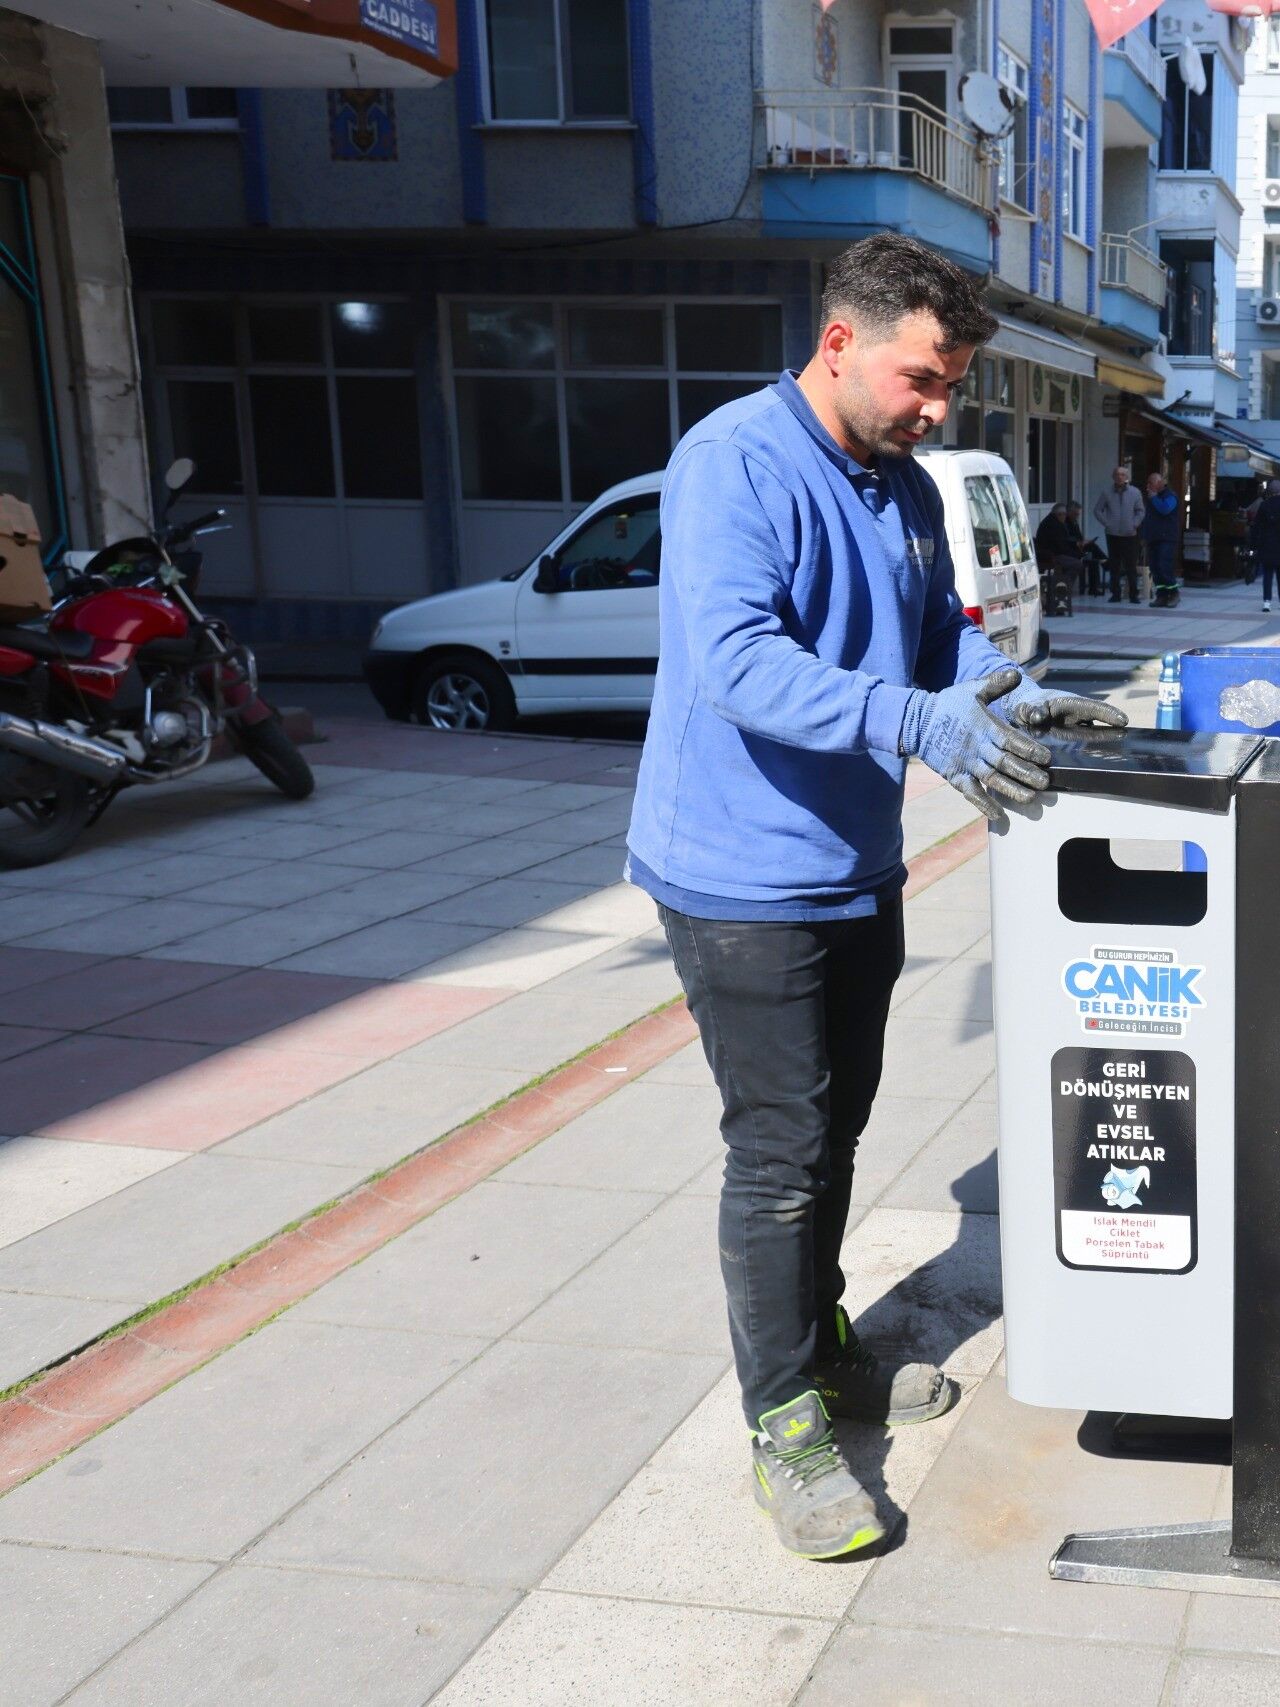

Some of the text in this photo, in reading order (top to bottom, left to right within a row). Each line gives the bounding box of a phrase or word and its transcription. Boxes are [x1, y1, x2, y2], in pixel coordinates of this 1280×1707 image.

[1097, 951, 1108, 959] BU
[1109, 951, 1133, 960] GURUR
[1098, 1021, 1178, 1033] Geleceğin İncisi
[1102, 1061, 1146, 1078] GERİ
[1060, 1079, 1190, 1101] DÖNÜŞMEYEN
[1113, 1104, 1137, 1119] VE
[1097, 1124, 1154, 1141] EVSEL
[1087, 1144, 1165, 1162] ATIKLAR
[1094, 1216, 1156, 1228] Islak Mendil
[1110, 1228, 1140, 1237] Ciklet
[1086, 1238, 1165, 1249] Porselen Tabak
[1102, 1249, 1149, 1259] Süprüntü
